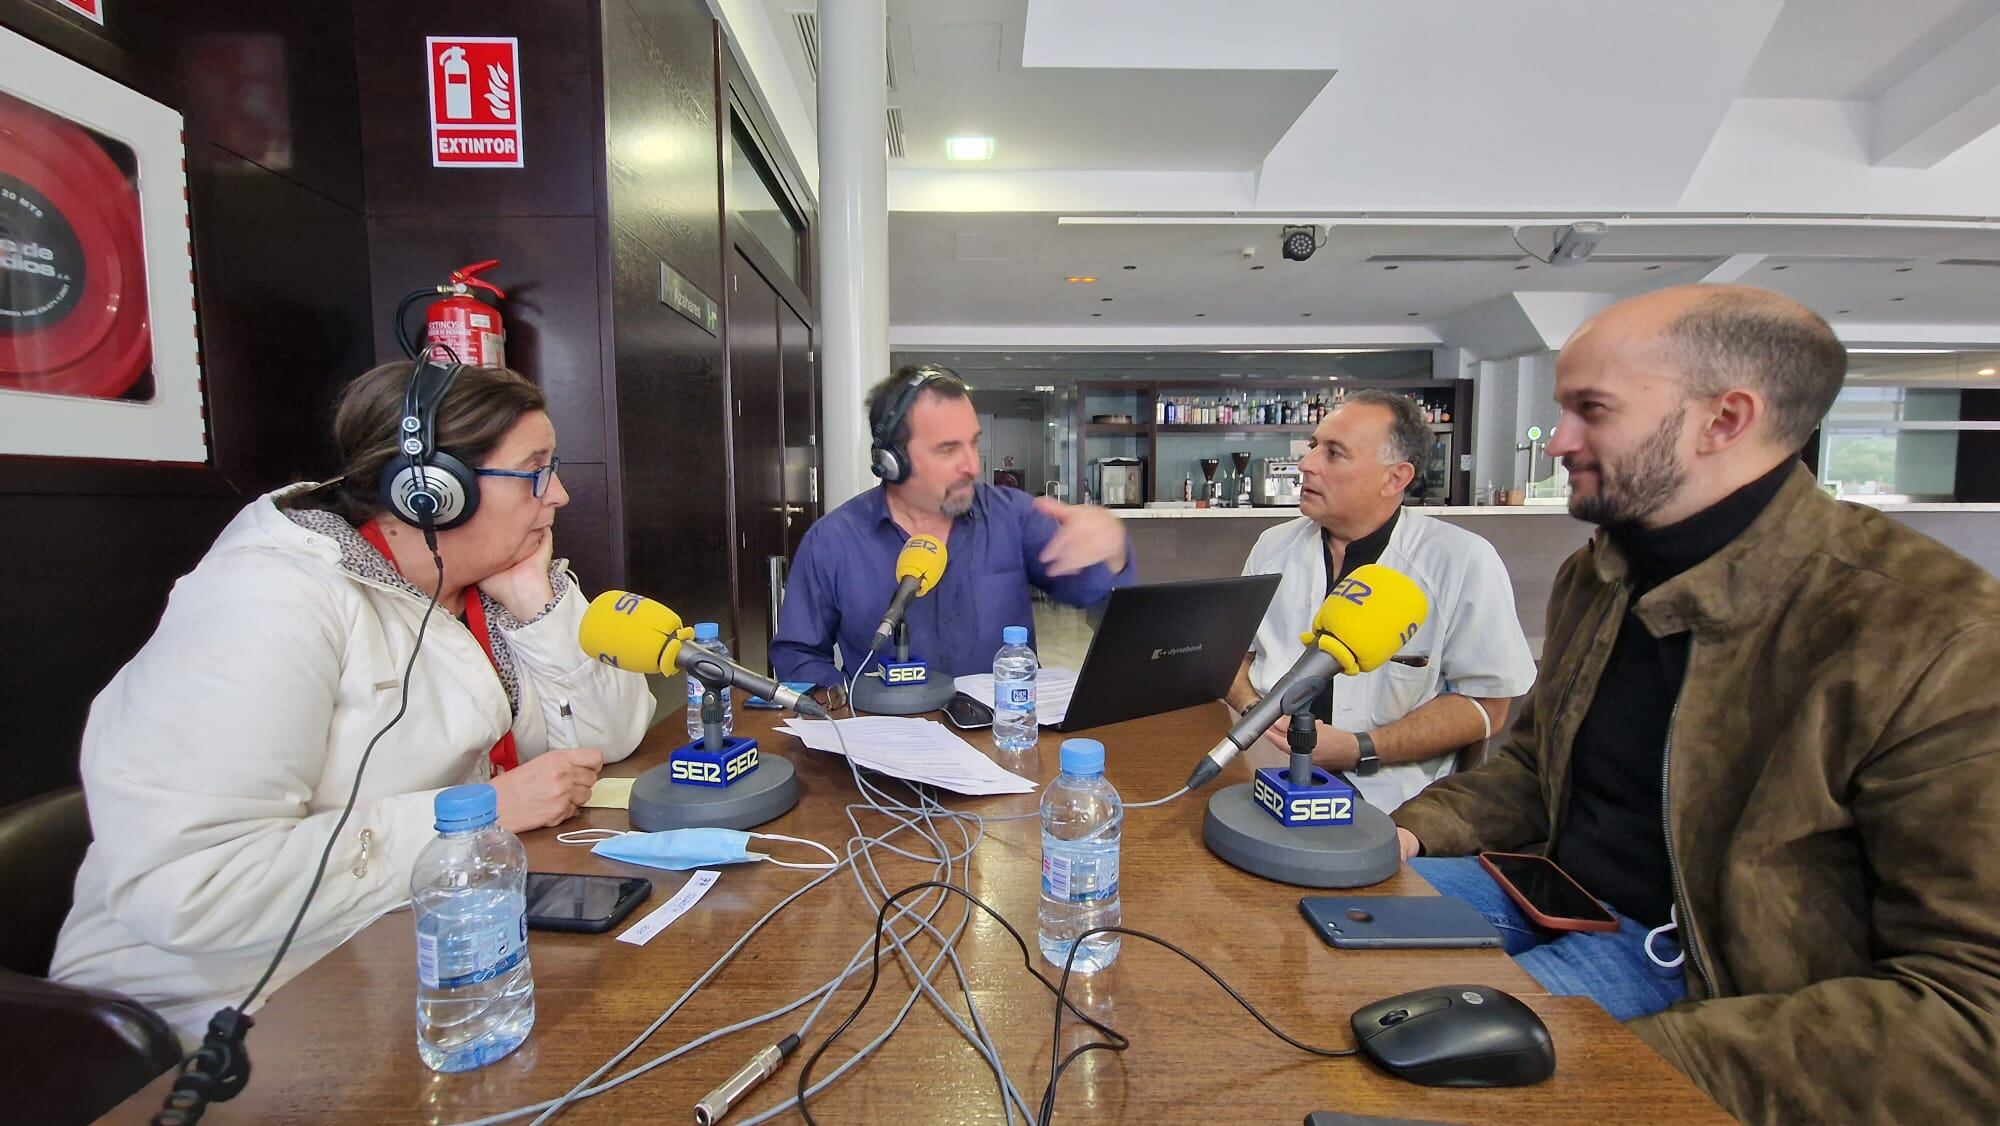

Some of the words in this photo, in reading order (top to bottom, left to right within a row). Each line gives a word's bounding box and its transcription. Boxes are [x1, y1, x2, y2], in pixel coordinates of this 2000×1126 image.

[439, 137, 516, 154] EXTINTOR
[22, 242, 54, 260] de
[904, 539, 938, 555] ER
[1330, 578, 1373, 606] ER
[888, 666, 926, 682] SER
[671, 759, 722, 783] SER
[726, 747, 759, 781] SER
[1254, 778, 1285, 818] SER
[1290, 797, 1352, 821] SER
